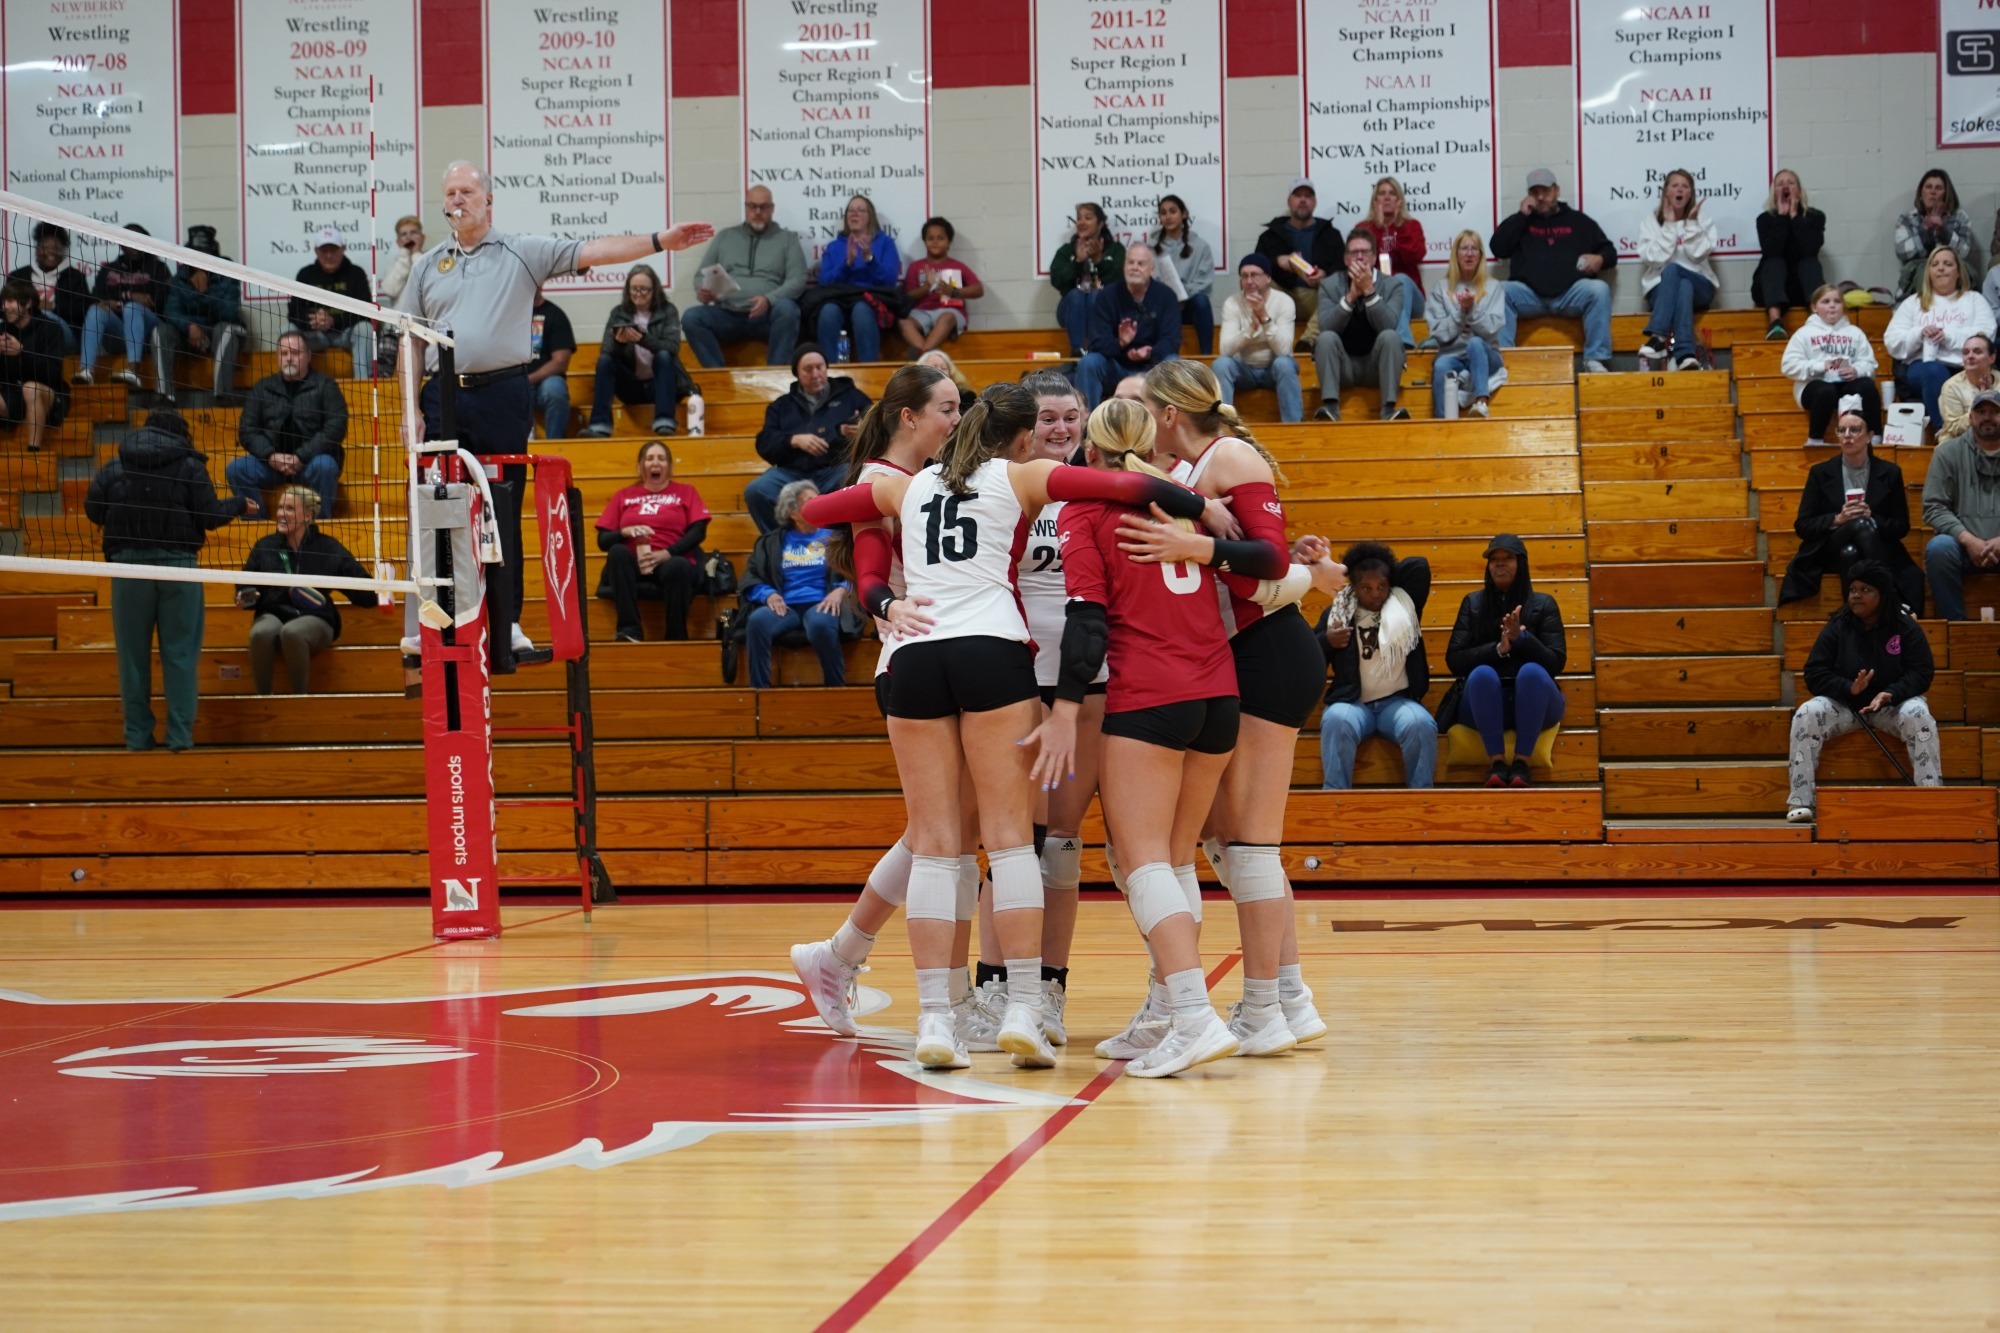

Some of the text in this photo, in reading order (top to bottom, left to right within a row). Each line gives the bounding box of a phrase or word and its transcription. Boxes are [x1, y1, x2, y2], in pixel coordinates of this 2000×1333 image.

[792, 0, 878, 17] Wrestling
[1639, 6, 1710, 21] NCAA II
[534, 7, 619, 26] Wrestling
[1091, 9, 1167, 30] 2011-12
[1365, 9, 1430, 24] NCAA II
[286, 16, 369, 35] Wrestling
[798, 22, 871, 42] 2010-11
[49, 24, 130, 44] Wrestling
[539, 30, 615, 51] 2009-10
[1339, 23, 1456, 44] Super Region I
[1615, 25, 1734, 46] Super Region I
[290, 39, 367, 59] 2008-09
[1093, 35, 1164, 50] NCAA II
[52, 52, 127, 73] 2007-08
[543, 55, 611, 71] NCAA II
[801, 48, 869, 63] NCAA II
[1070, 53, 1187, 73] Super Region I
[1353, 47, 1443, 64] Champions
[1629, 48, 1722, 65] Champions
[296, 65, 362, 80] NCAA II
[778, 66, 892, 86] Super Region I
[521, 74, 632, 94] Super Region I
[1085, 76, 1174, 92] Champions
[1366, 75, 1431, 90] NCAA II
[58, 83, 123, 98] NCAA II
[274, 85, 316, 102] Super
[378, 83, 383, 96] I
[793, 88, 879, 105] Champions
[1641, 88, 1711, 102] NCAA II
[535, 96, 620, 112] Champions
[1094, 94, 1165, 109] NCAA II
[1309, 95, 1490, 115] National Championships
[36, 103, 77, 119] Super
[138, 101, 143, 112] I
[288, 104, 371, 121] Champions
[802, 106, 871, 121] NCAA II
[1583, 107, 1768, 125] National Championships
[544, 113, 611, 128] NCAA II
[1041, 112, 1219, 129] National Championships
[1363, 117, 1435, 132] 6th Place
[50, 124, 131, 139] Champions
[296, 122, 363, 137] NCAA II
[750, 124, 924, 141] National Championships
[1636, 128, 1715, 143] 21st Place
[493, 131, 665, 149] National Championships
[1095, 131, 1165, 145] 5th Place
[58, 144, 124, 159] NCAA II
[247, 142, 304, 157] National
[802, 144, 871, 158] 6th Place
[1311, 140, 1490, 159] NCWA National Duals
[544, 152, 612, 166] 8th Place
[1042, 153, 1220, 170] NWCA National Duals
[9, 165, 174, 183] National Championships
[294, 162, 367, 176] Runnerup
[751, 165, 924, 182] NWCA National Duals
[1364, 160, 1436, 174] 5th Place
[1646, 167, 1706, 182] Raed
[494, 171, 665, 189] NWCA National Duals
[1088, 171, 1174, 188] Runner-Up
[58, 187, 124, 201] 8th Place
[248, 180, 415, 197] NWCA National Duals
[803, 184, 872, 198] 4th Place
[1610, 187, 1639, 200] No.
[1643, 187, 1652, 199] 9
[540, 190, 619, 205] Runner-up
[1102, 195, 1161, 208] Ranked
[293, 199, 370, 213] Runner-up
[551, 212, 608, 225] Ranked
[808, 227, 815, 239] 3
[271, 241, 298, 254] No.
[304, 241, 311, 252] 3
[1651, 377, 1664, 387] 10
[1656, 409, 1664, 420] 9
[1665, 485, 1673, 496] 7
[920, 492, 979, 566] 15
[1669, 524, 1677, 534] 6
[1676, 617, 1686, 630] 4
[1679, 670, 1688, 682] 3
[1688, 721, 1696, 734] 2
[448, 755, 468, 866] sports imports
[442, 878, 482, 912] N
